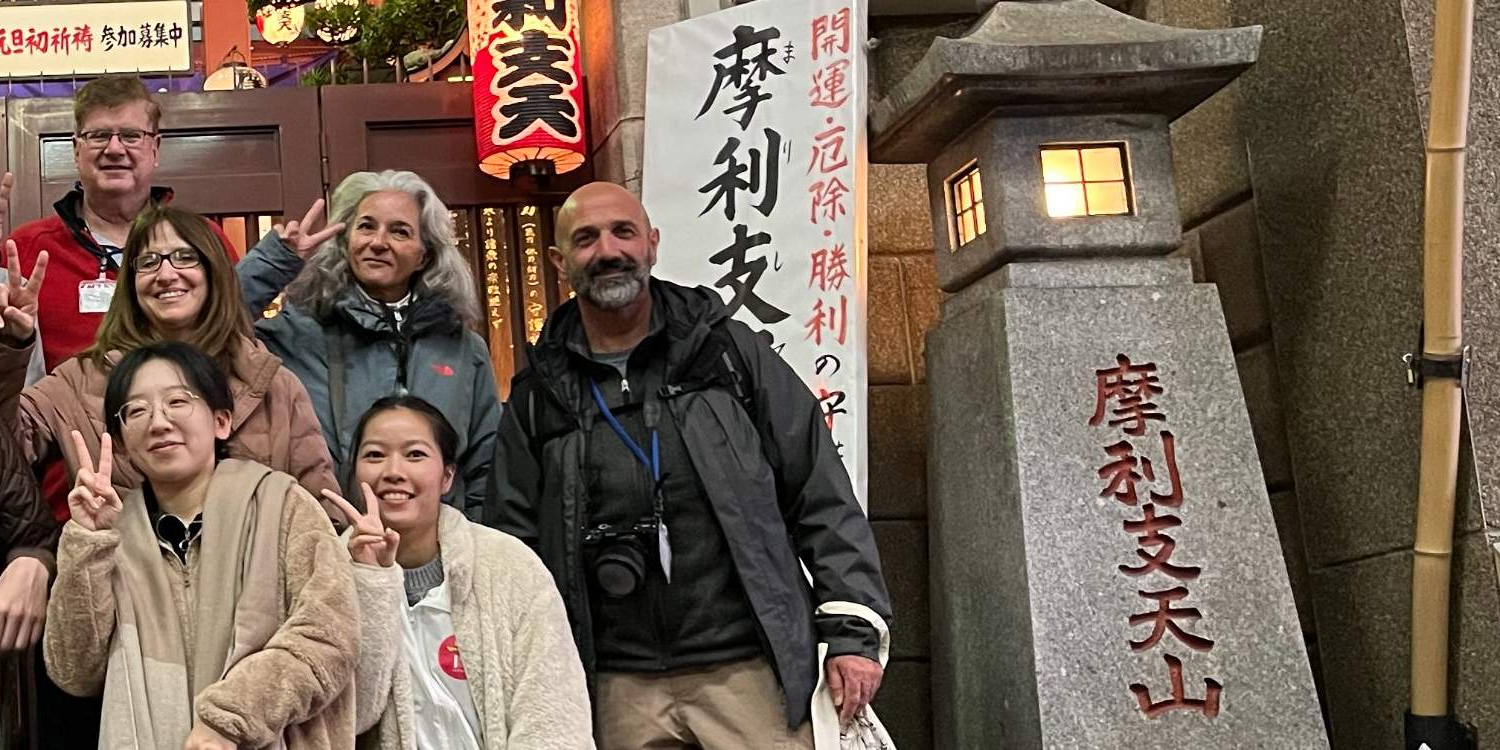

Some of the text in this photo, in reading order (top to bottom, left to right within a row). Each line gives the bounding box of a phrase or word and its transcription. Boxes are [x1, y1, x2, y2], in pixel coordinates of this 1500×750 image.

[694, 25, 791, 344] 摩利支
[1088, 353, 1221, 718] 摩利支天山
